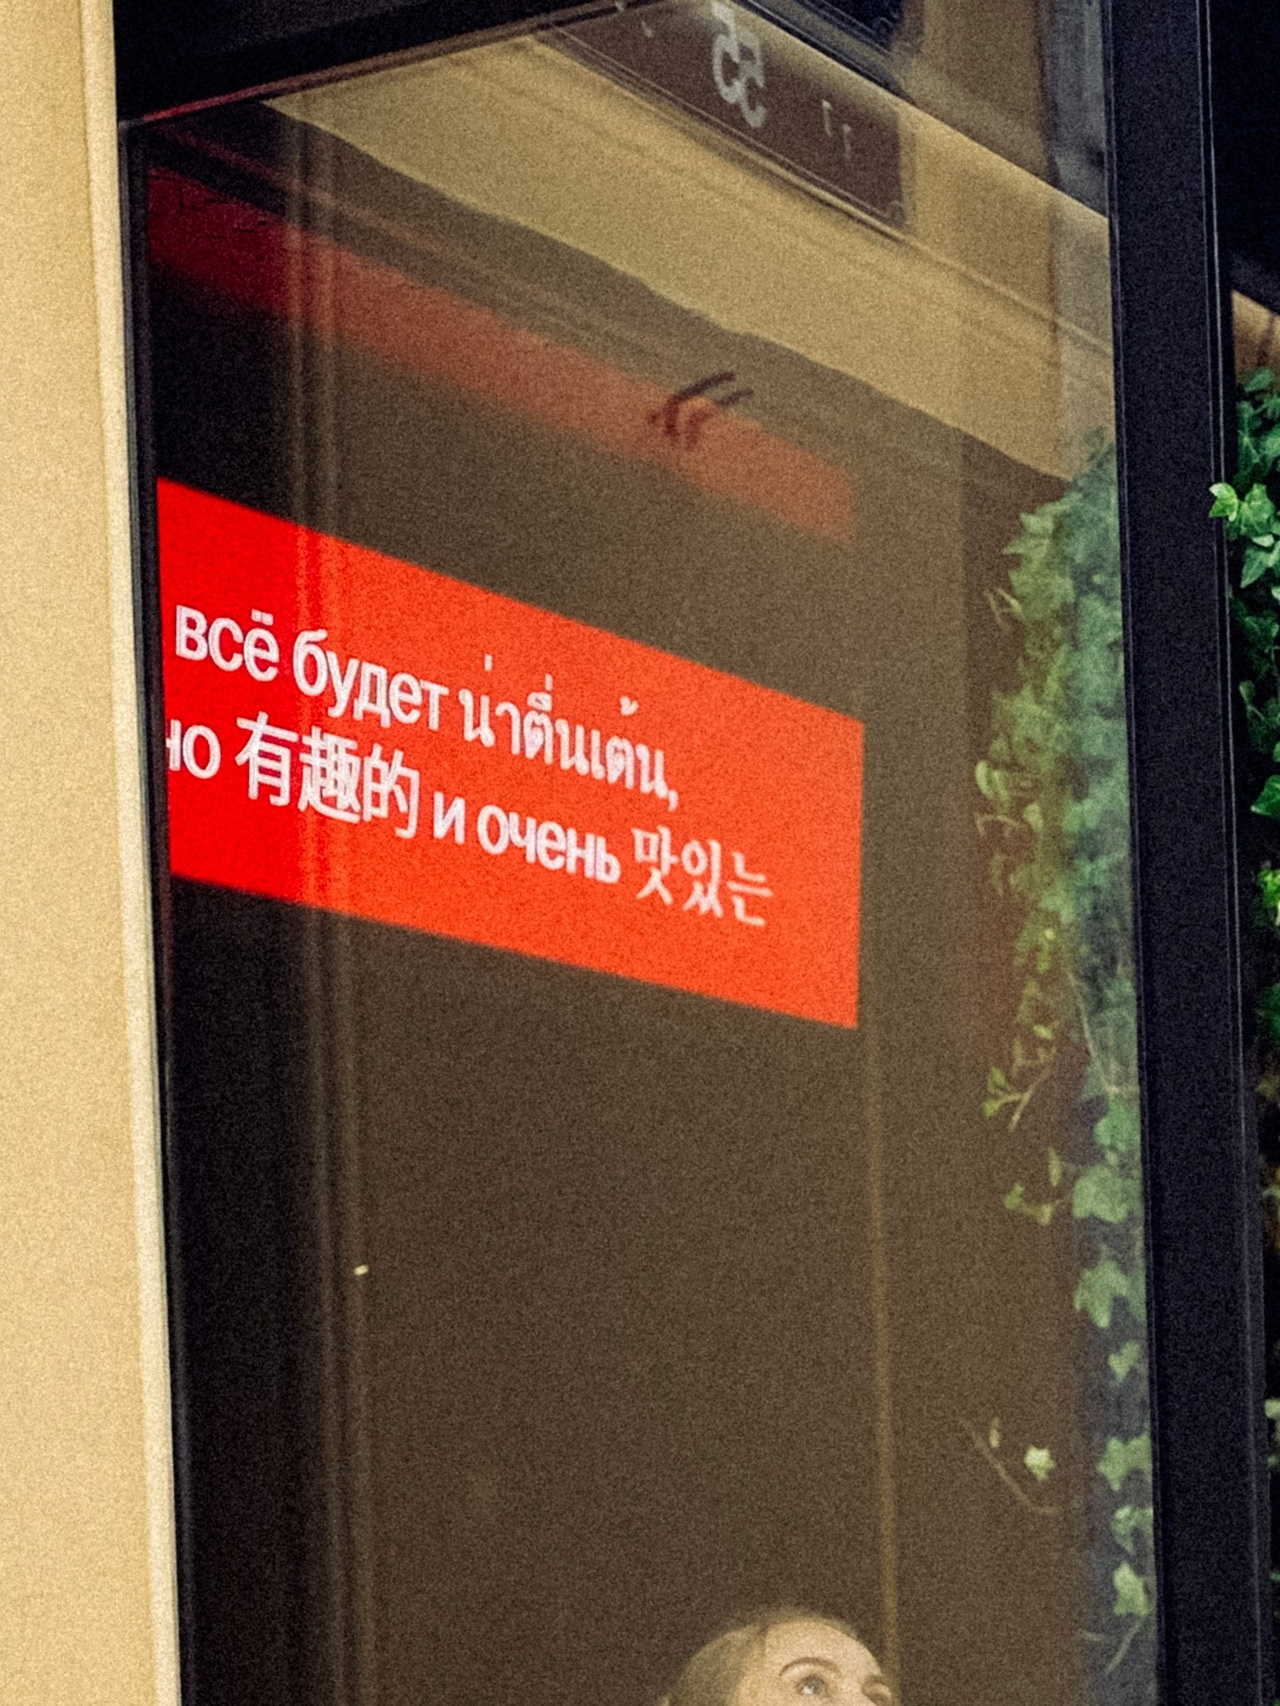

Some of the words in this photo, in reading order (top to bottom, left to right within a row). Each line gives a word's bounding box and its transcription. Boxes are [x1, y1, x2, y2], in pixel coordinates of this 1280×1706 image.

[175, 604, 280, 682] всё
[293, 628, 449, 731] будет
[235, 711, 420, 839] 有趣的
[433, 790, 466, 845] и
[477, 804, 622, 884] очень
[631, 825, 773, 927] 맛있는
